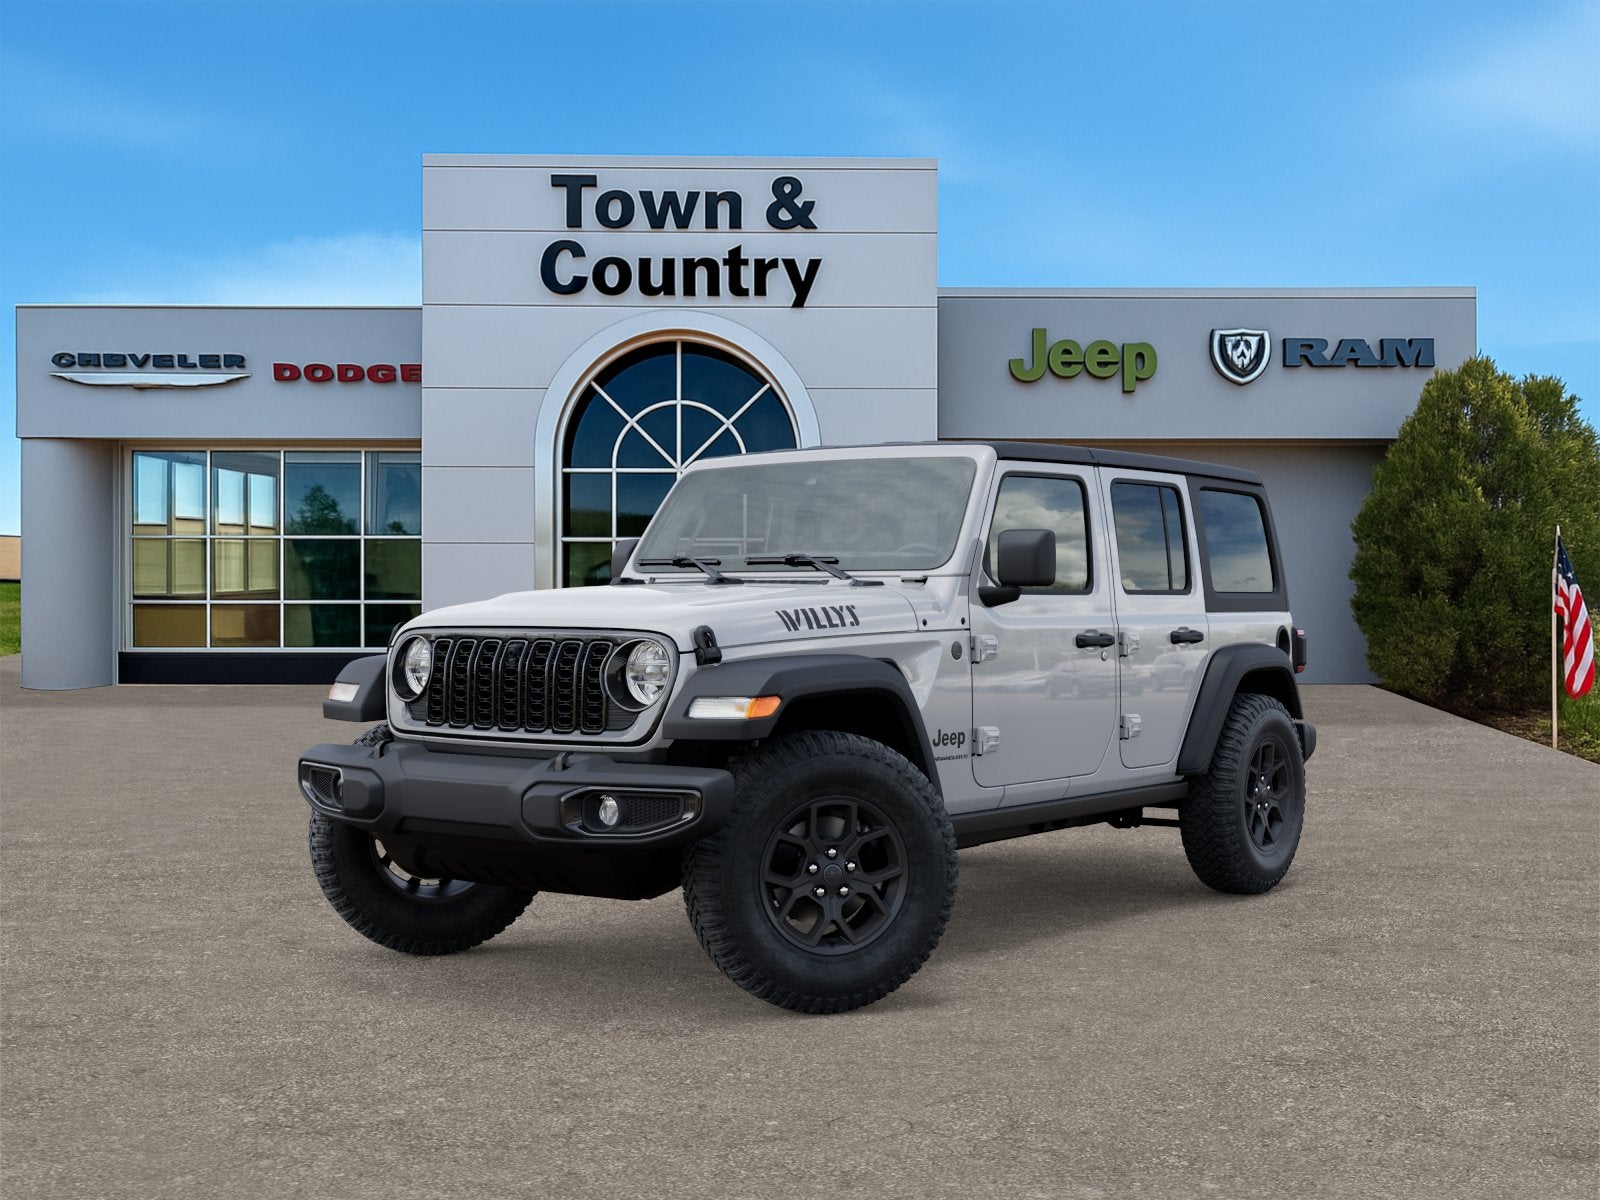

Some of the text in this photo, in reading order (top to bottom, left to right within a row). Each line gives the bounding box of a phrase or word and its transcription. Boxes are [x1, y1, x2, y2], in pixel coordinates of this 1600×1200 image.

[550, 174, 818, 230] Town &
[539, 239, 823, 308] Country
[1008, 327, 1158, 394] Jeep
[1281, 337, 1436, 368] RAM
[272, 362, 422, 383] DODGE
[774, 604, 860, 632] WILLYS
[932, 728, 966, 749] Jeep
